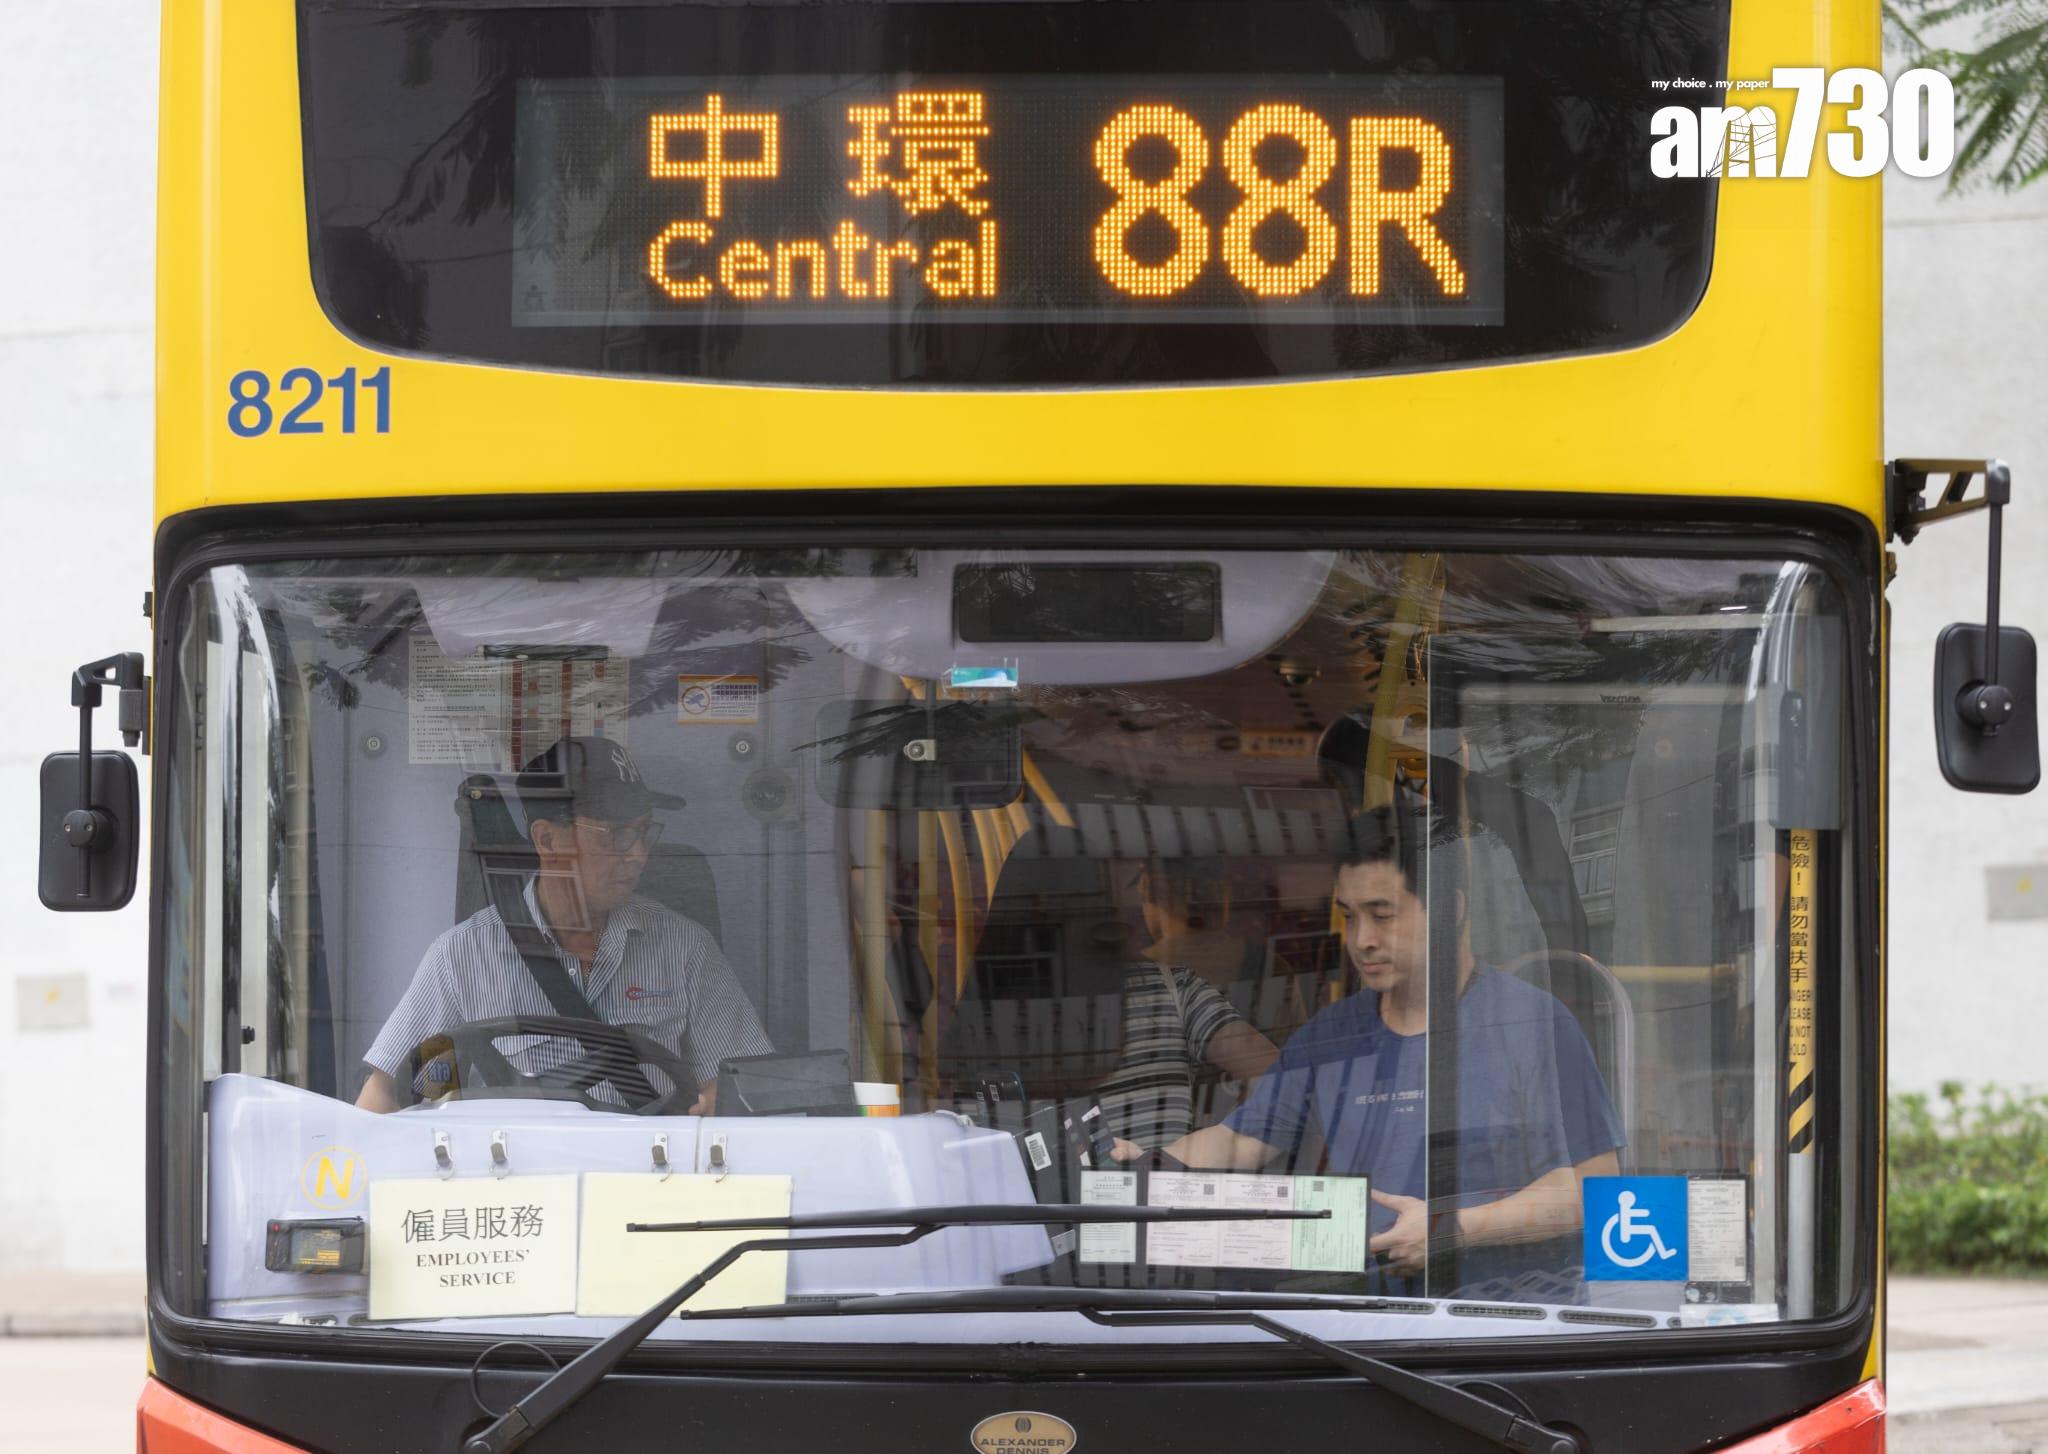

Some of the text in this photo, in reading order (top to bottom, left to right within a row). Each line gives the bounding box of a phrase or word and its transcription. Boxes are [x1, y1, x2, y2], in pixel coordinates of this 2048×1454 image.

[650, 92, 990, 218] 中環
[1095, 104, 1465, 295] 88R
[650, 220, 996, 298] Central
[227, 366, 391, 438] 8211
[401, 1203, 545, 1246] 僱員服務
[416, 1249, 531, 1268] EMPLOYEES'
[439, 1271, 516, 1288] SERVICE
[980, 1438, 1066, 1447] ALEXANDER
